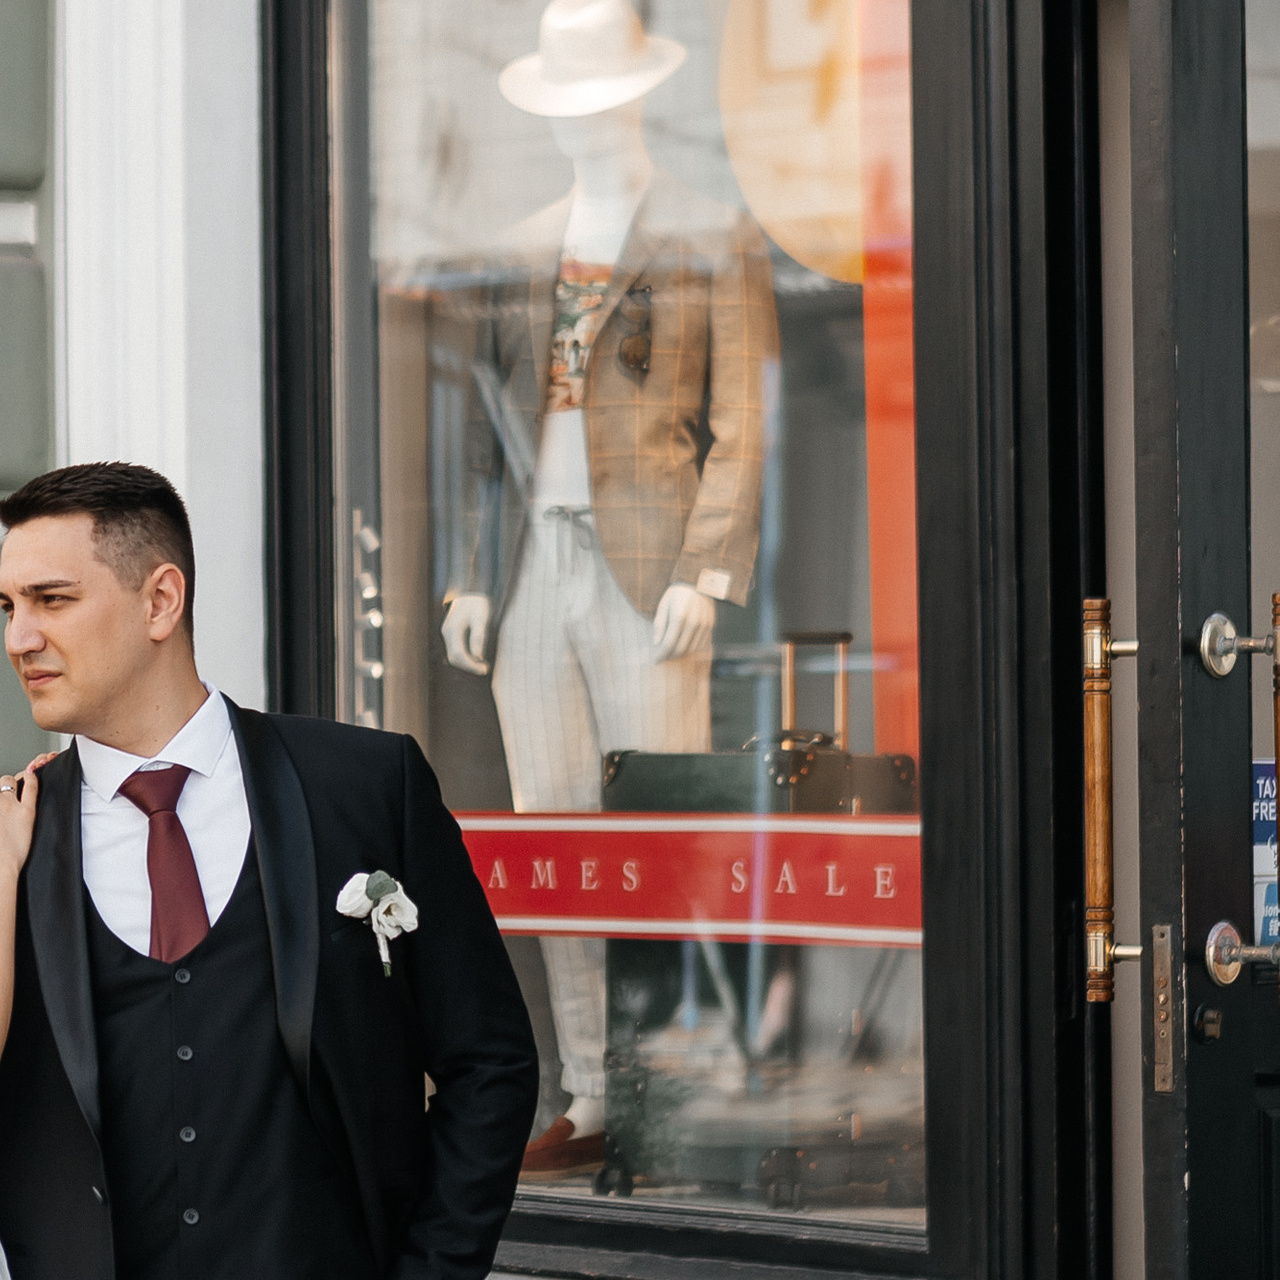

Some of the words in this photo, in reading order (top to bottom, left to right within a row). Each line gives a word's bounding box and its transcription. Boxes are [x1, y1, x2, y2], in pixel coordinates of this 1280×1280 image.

[1253, 801, 1277, 821] FRE
[487, 859, 641, 893] AMES
[731, 860, 896, 900] SALE
